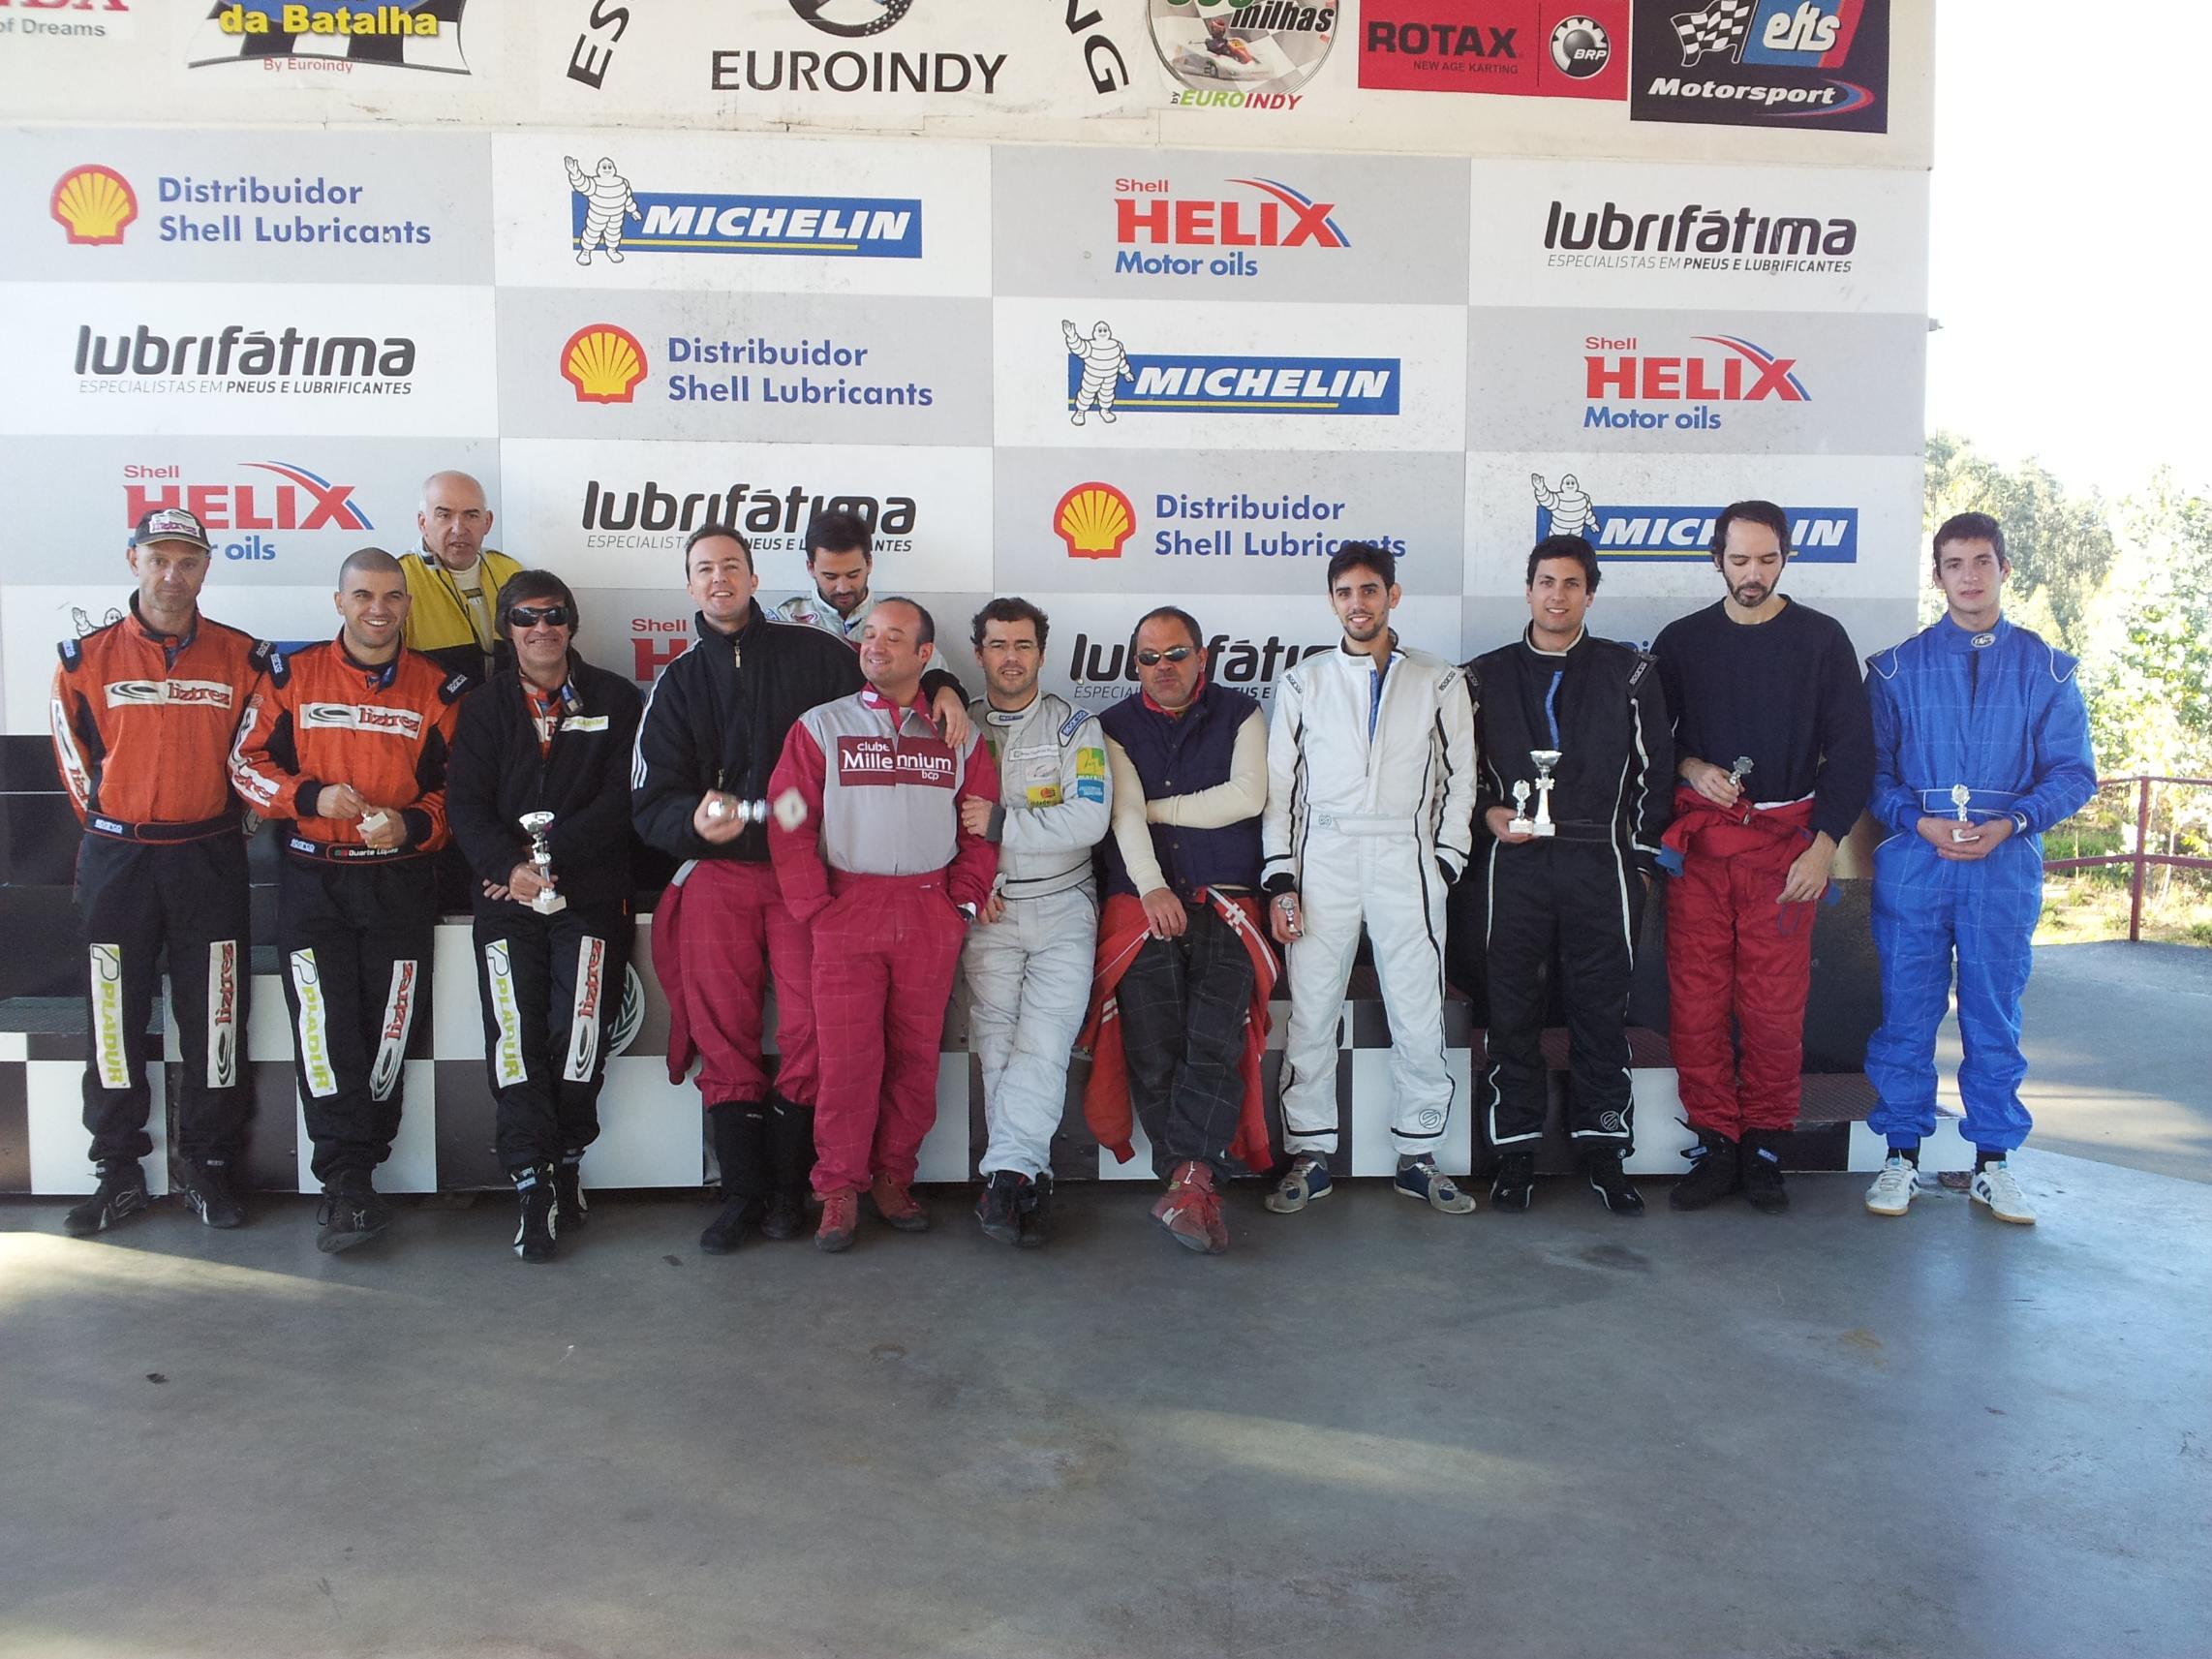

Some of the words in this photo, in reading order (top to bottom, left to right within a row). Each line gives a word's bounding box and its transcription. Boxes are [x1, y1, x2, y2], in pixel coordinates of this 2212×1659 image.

[22, 18, 106, 37] Dreams
[220, 4, 268, 34] da
[283, 5, 439, 36] Batalha
[1367, 20, 1517, 58] ROTAX
[263, 59, 282, 73] By
[289, 58, 353, 74] Euroindy
[1574, 49, 1607, 60] BRP
[711, 49, 1008, 94] EUROINDY
[1413, 60, 1439, 71] NEW
[1442, 61, 1464, 72] AGE
[1469, 62, 1519, 75] KARTING
[1170, 91, 1181, 105] by
[1181, 89, 1303, 110] EUROINDY
[1648, 77, 1836, 106] Motorsport
[159, 177, 363, 205] Distribuidor
[1115, 178, 1169, 193] Shell
[159, 214, 241, 242] Shell
[256, 215, 431, 245] Lubricants
[642, 205, 910, 240] MICHELIN
[1114, 198, 1344, 248] HELIX
[1544, 200, 1858, 256] lubrifátima
[1115, 251, 1203, 276] Motor
[1210, 252, 1258, 277] oils
[1548, 254, 1655, 270] ESPECIALISTAS
[1659, 257, 1680, 269] EM
[1683, 257, 1730, 271] PNEUS
[1733, 259, 1741, 271] E
[1744, 258, 1852, 273] LUBRIFICANTES
[75, 324, 416, 378] lubrifátima
[668, 337, 868, 366] Distribuidor
[1585, 336, 1637, 350] Shell
[79, 380, 196, 394] ESPECIALISTAS
[200, 381, 223, 394] EM
[226, 381, 276, 394] PNEUS
[281, 381, 290, 394] E
[293, 381, 413, 395] LUBRIFICANTES
[668, 375, 749, 403] Shell
[763, 377, 933, 407] Lubricants
[1134, 366, 1391, 399] MICHELIN
[1583, 355, 1803, 402] HELIX
[1583, 406, 1669, 429] Motor
[1674, 405, 1721, 429] oils
[124, 465, 179, 478] Shell
[1155, 494, 1345, 520] Distribuidor
[225, 536, 276, 561] oils
[786, 538, 795, 551] E
[1154, 530, 1231, 556] Shell
[630, 618, 687, 632] Shell
[857, 741, 890, 752] clube
[842, 749, 951, 771] Millennium
[922, 770, 939, 782] bcp
[349, 848, 375, 857] Duarte
[101, 982, 123, 1083] PLADUR
